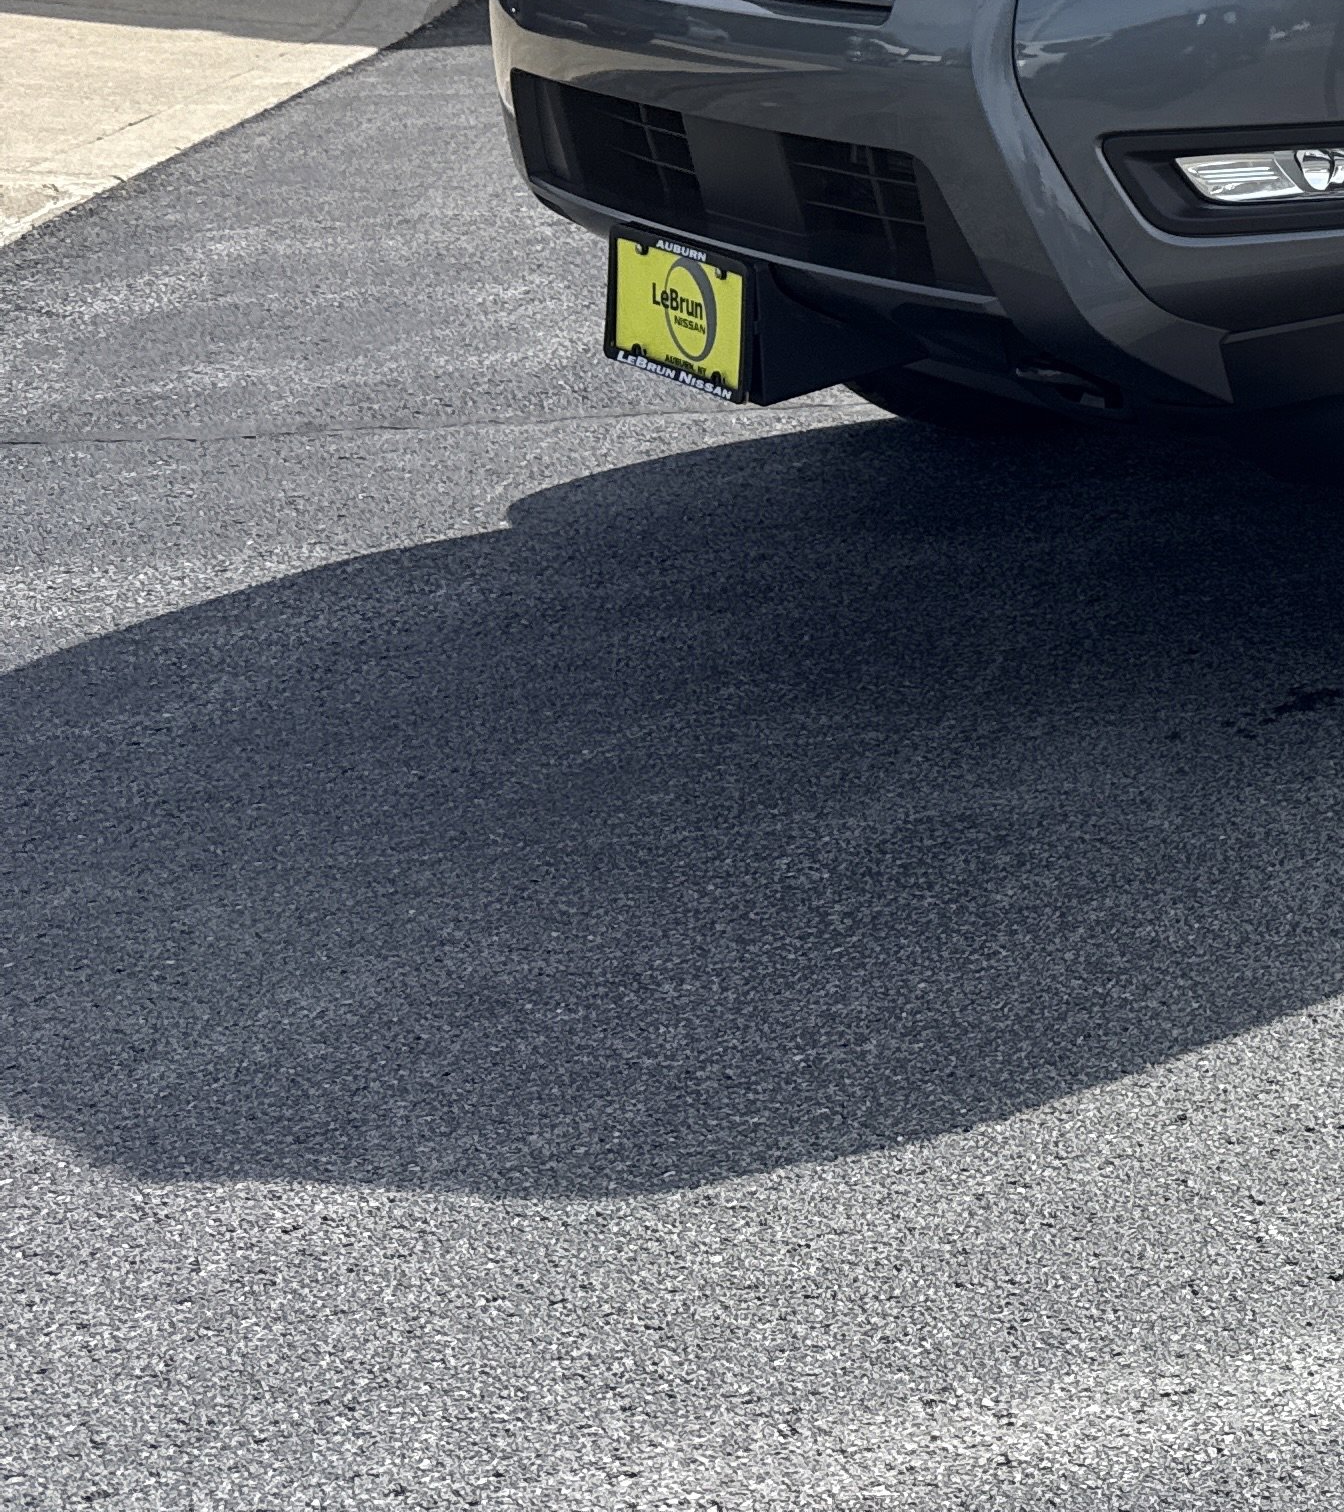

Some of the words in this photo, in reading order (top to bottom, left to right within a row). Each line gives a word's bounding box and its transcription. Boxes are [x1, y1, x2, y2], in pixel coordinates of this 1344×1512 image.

[655, 239, 707, 263] AUBURN
[651, 282, 704, 321] LeBrun
[673, 314, 707, 335] NISSAN
